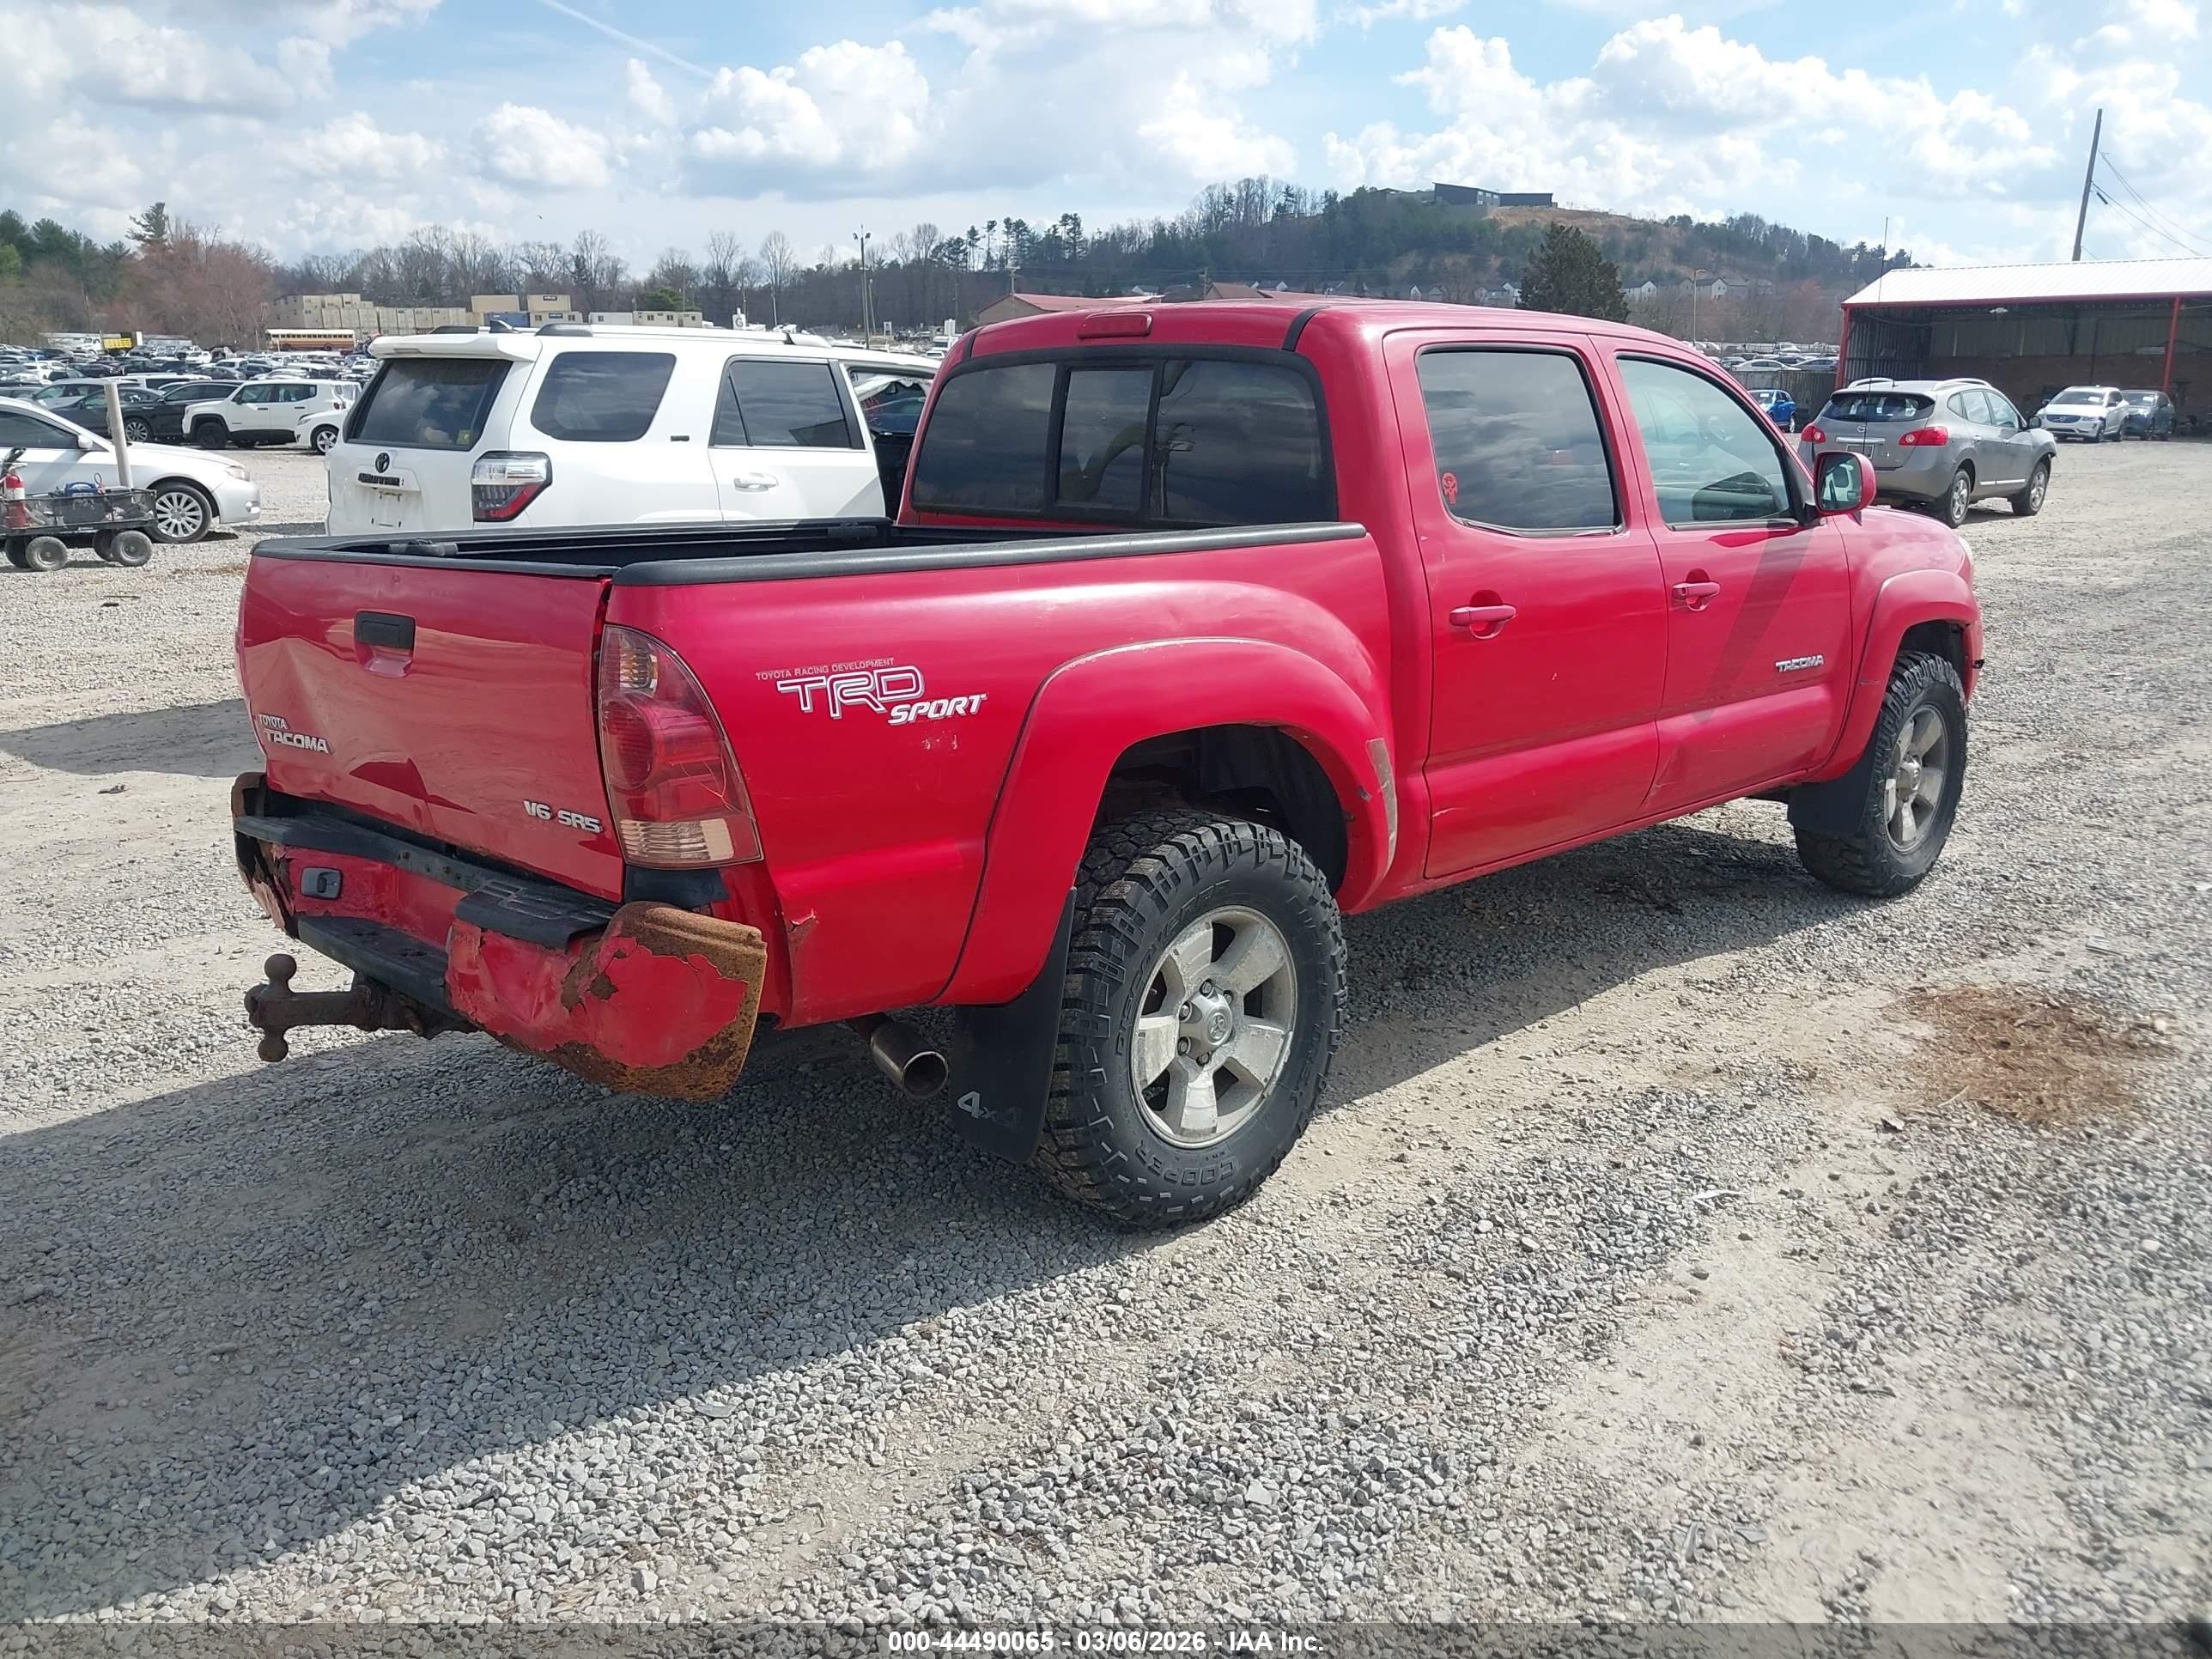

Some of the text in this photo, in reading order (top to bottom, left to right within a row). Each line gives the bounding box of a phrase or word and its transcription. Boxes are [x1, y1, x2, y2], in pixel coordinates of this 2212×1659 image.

[756, 658, 895, 681] TOYOTA RACING DEVELOPMENT
[1775, 655, 1825, 673] TACOMA
[776, 665, 926, 720] TRD
[258, 714, 289, 730] TOYOTA
[887, 692, 989, 726] SPORT
[264, 728, 331, 755] TACOMA
[523, 800, 604, 834] V6 SR5
[1134, 1139, 1237, 1186] COOPER
